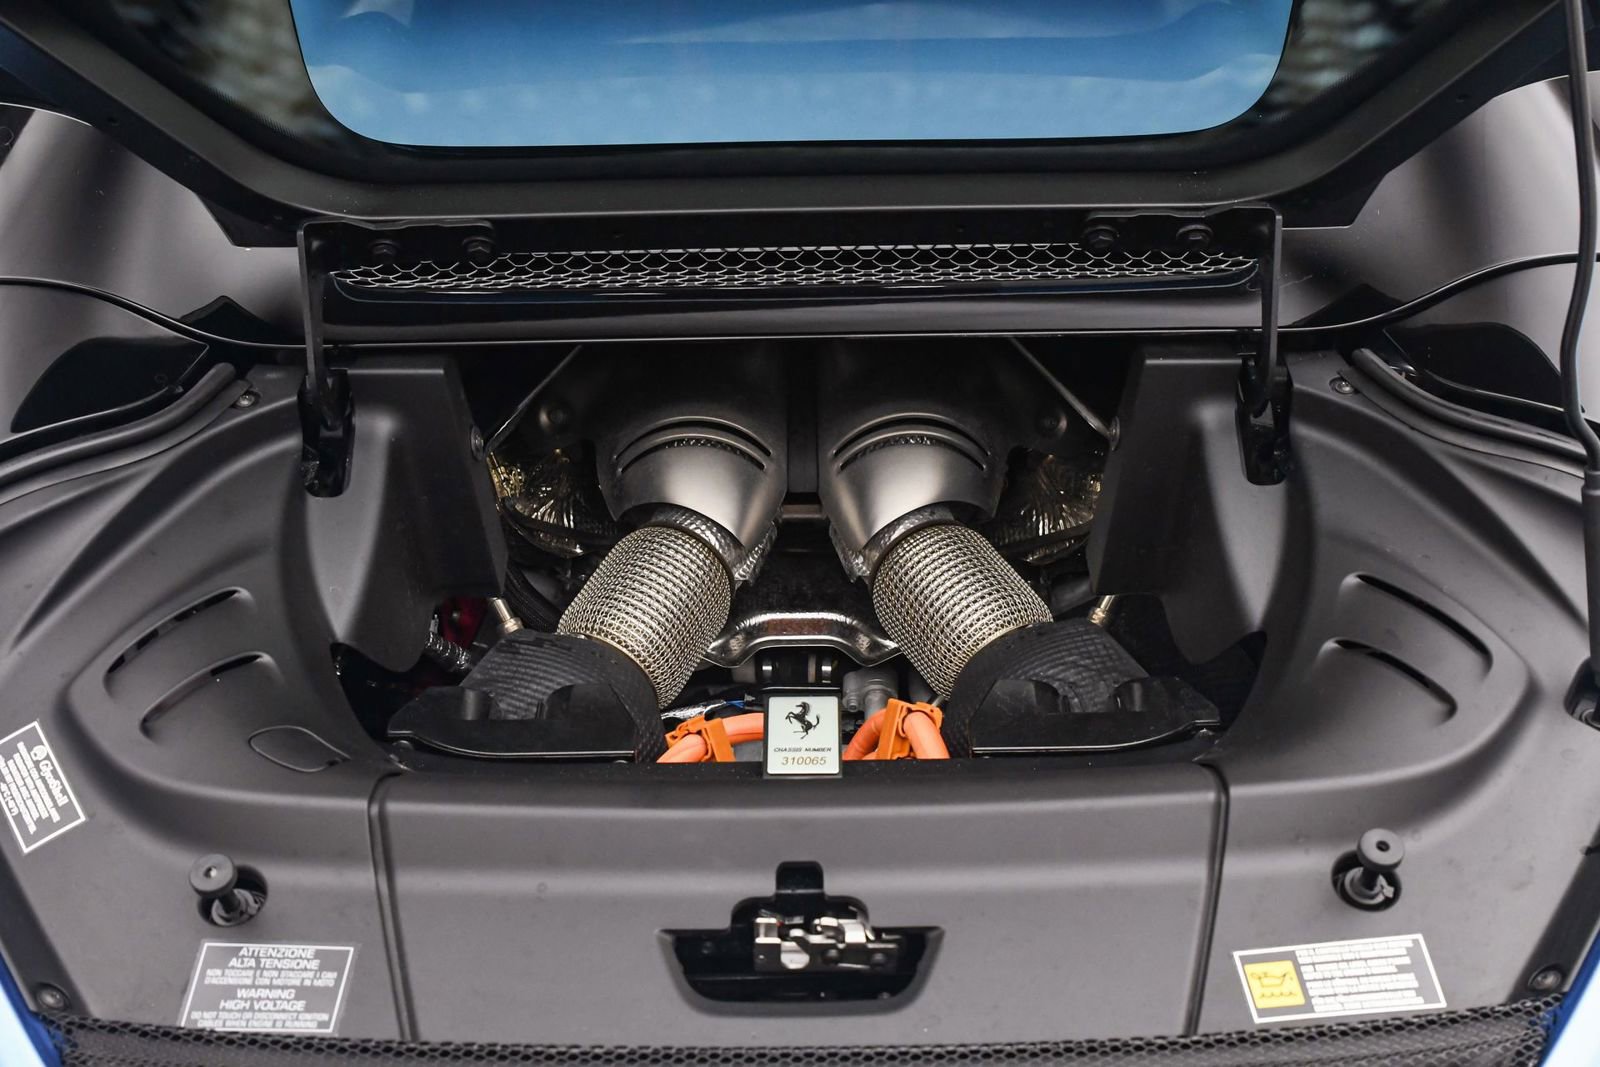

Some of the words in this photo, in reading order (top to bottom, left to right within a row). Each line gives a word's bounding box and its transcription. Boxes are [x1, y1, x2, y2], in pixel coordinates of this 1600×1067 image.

[782, 756, 827, 766] 310065
[239, 947, 316, 959] ATTENZIONE
[228, 957, 256, 968] ALTA
[260, 958, 320, 970] TENSIONE
[237, 988, 296, 999] WARNING
[220, 999, 251, 1010] HIGH
[253, 1000, 306, 1012] VOLTAGE
